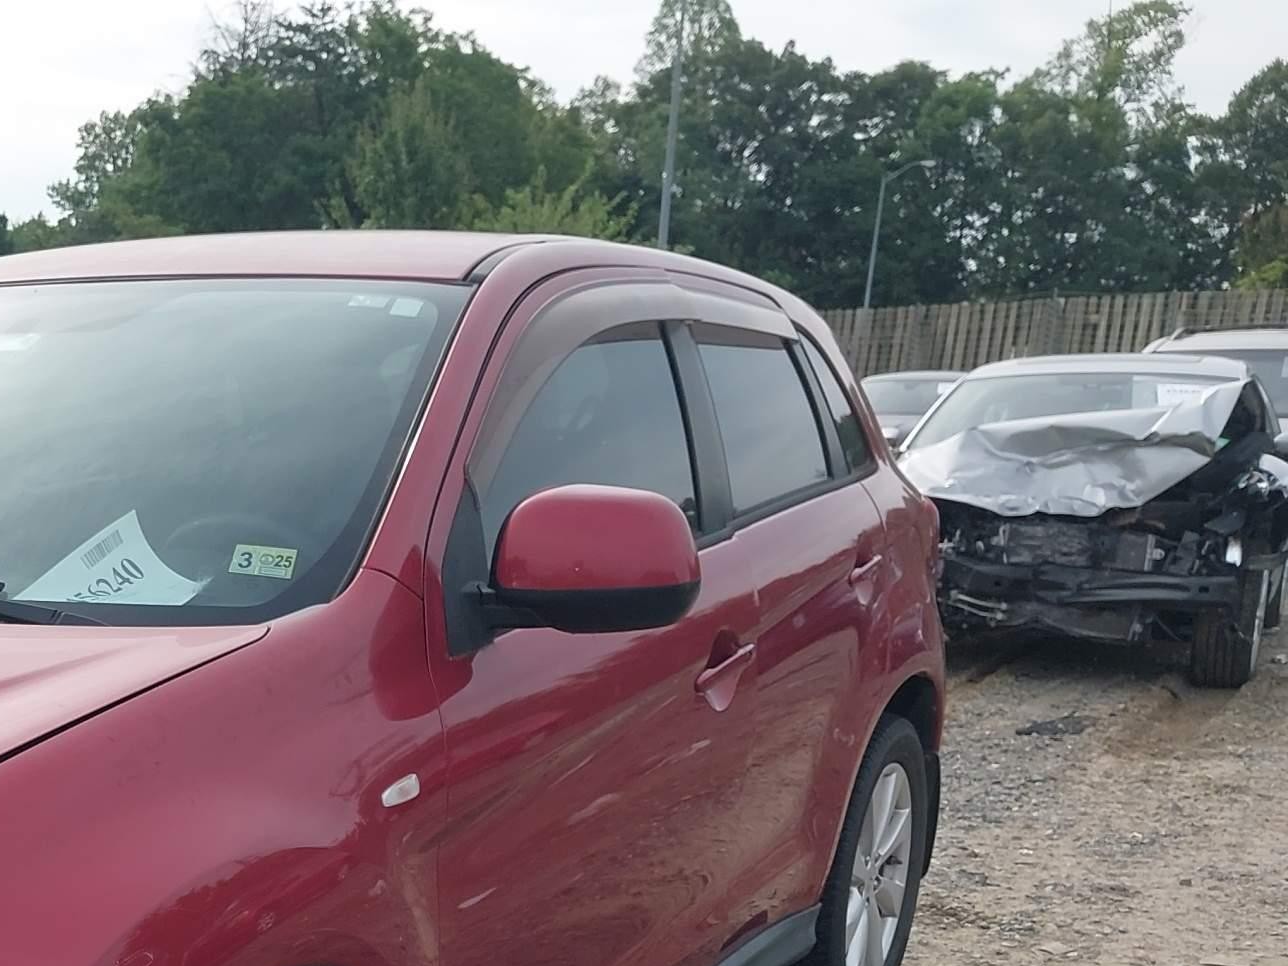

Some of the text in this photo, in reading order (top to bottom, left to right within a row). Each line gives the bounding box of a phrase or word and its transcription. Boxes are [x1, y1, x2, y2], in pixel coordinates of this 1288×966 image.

[238, 551, 294, 569] 3 25
[66, 558, 145, 602] 56240
